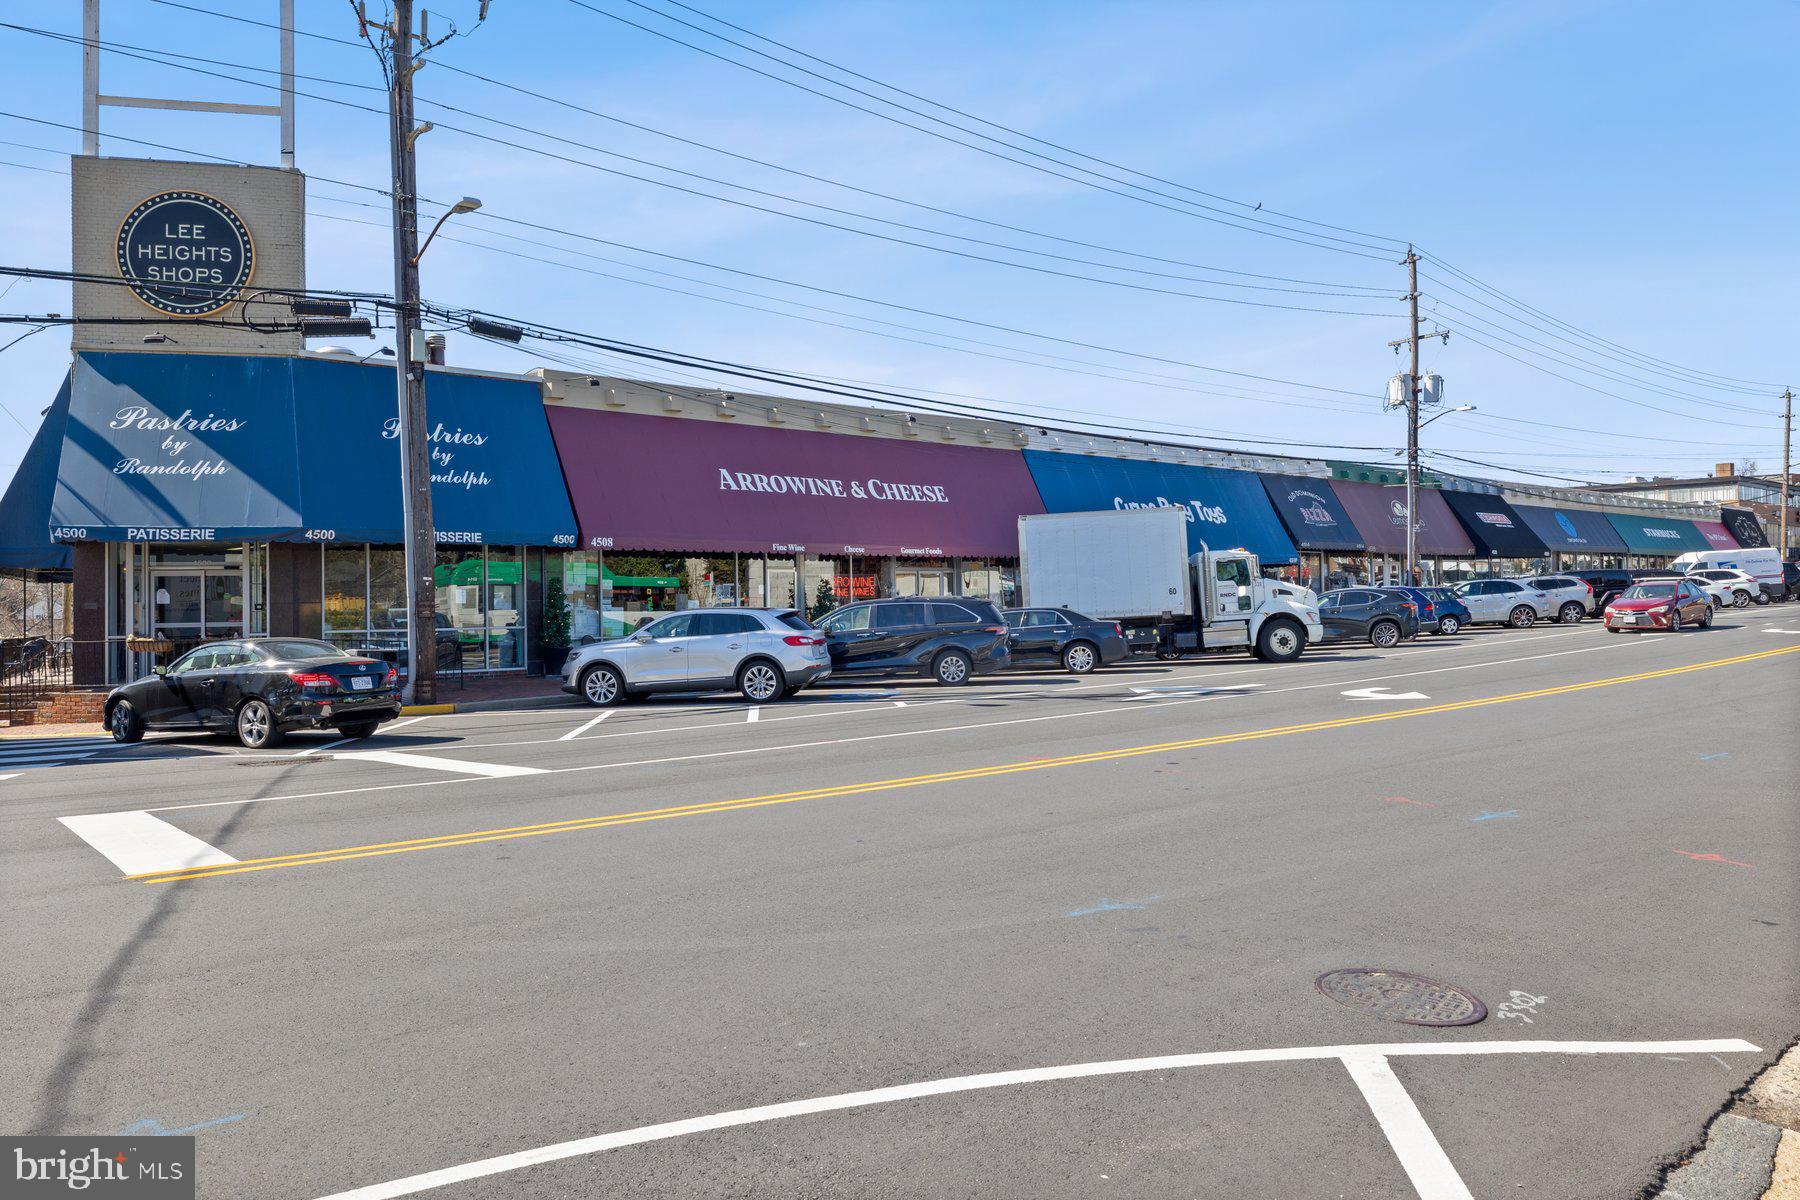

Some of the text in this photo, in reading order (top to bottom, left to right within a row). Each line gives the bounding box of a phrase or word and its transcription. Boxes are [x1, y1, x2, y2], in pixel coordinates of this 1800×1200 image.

[165, 223, 206, 239] LEE
[138, 244, 232, 262] HEIGHTS
[148, 266, 223, 283] SHOPS
[109, 406, 247, 431] Pastries
[161, 434, 192, 456] by
[431, 447, 455, 467] by
[112, 457, 231, 481] Randolph
[429, 469, 492, 490] ndolph
[718, 468, 949, 503] ARROWINE & CHEESE
[1287, 490, 1326, 504] OLD DOMINION
[1189, 500, 1227, 524] Toys
[1299, 507, 1334, 522] PIZZA
[54, 528, 87, 538] 4500
[127, 528, 215, 540] PATISSERIE
[304, 529, 335, 540] 4500
[552, 534, 575, 545] 4500
[1643, 528, 1680, 539] STARBUCKS
[591, 537, 613, 547] 4508
[772, 543, 805, 552] Fine Wine
[844, 545, 865, 553] Cheese
[900, 547, 924, 555] Gourmet
